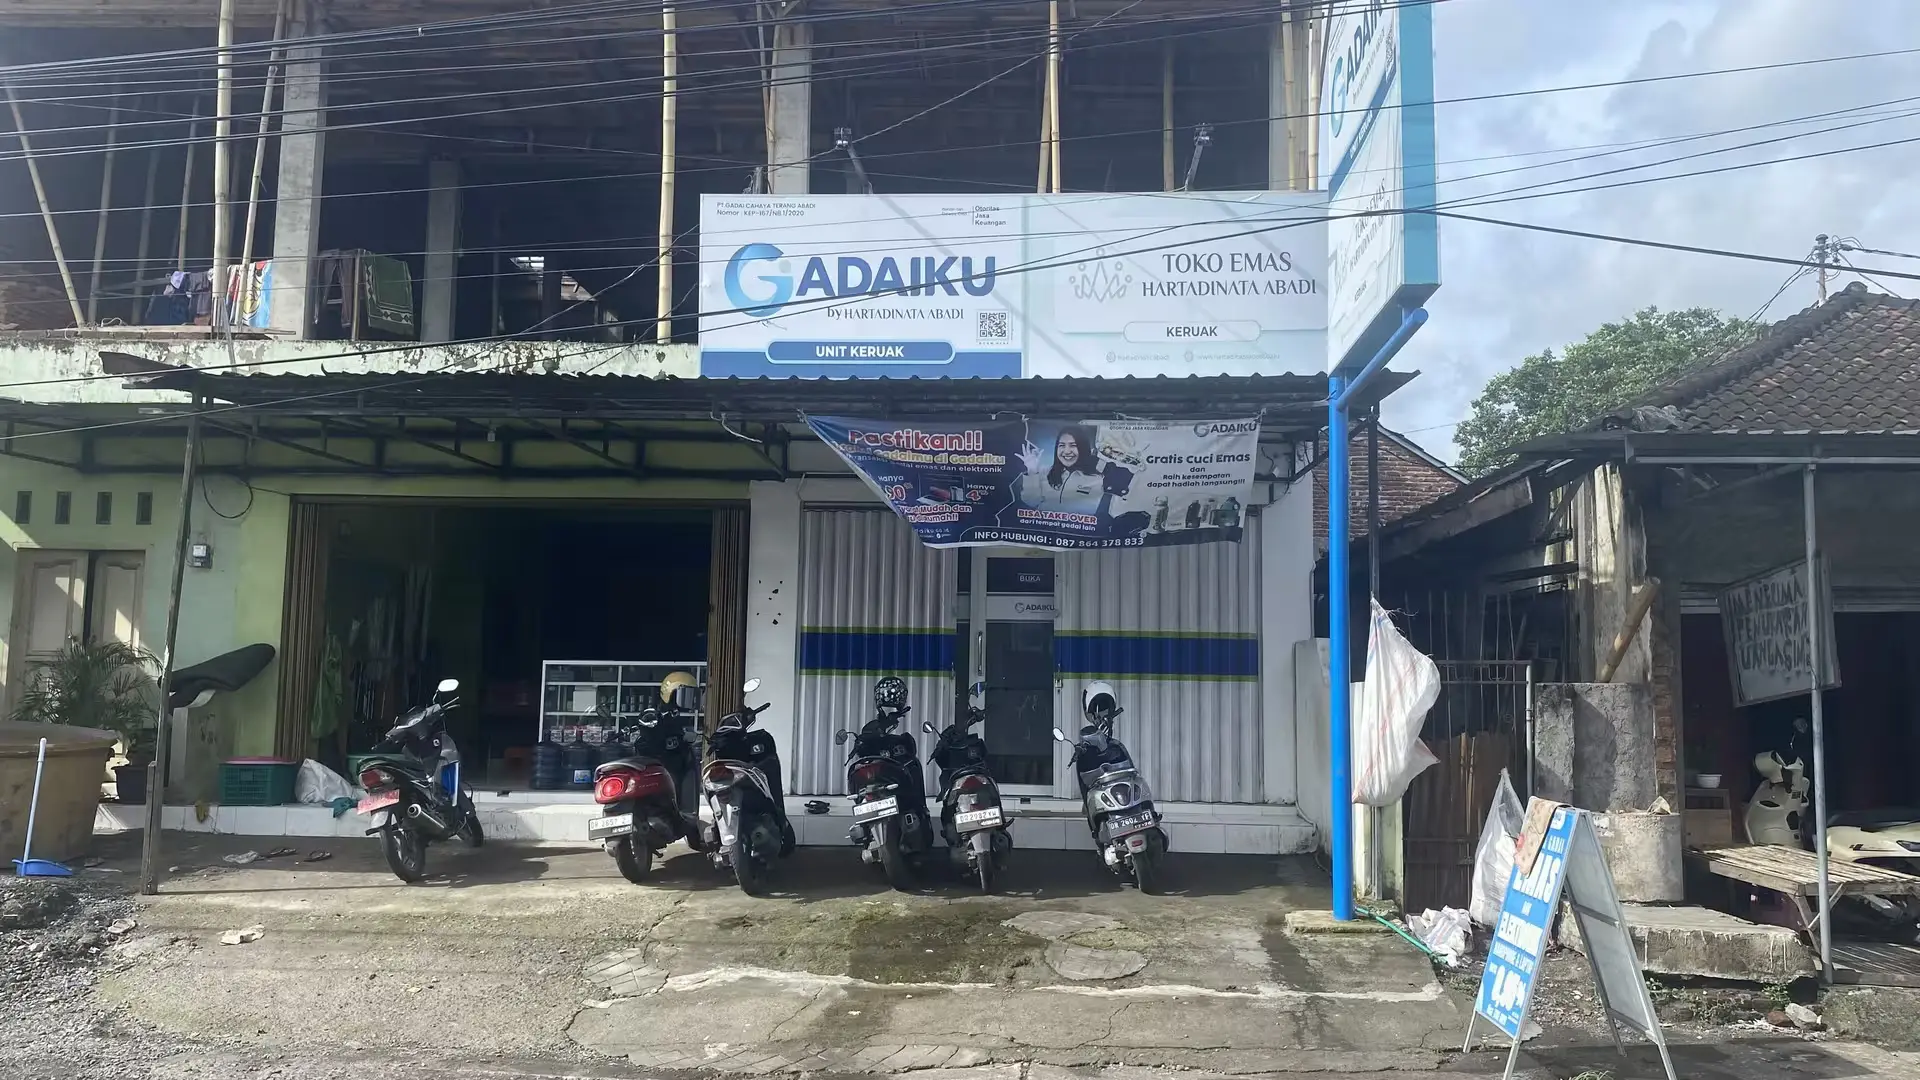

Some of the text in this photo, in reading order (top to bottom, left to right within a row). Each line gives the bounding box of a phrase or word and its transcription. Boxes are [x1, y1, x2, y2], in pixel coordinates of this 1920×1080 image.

[1162, 251, 1292, 273] TOKO EMAS
[724, 242, 996, 318] GADAIKU
[1142, 278, 1316, 297] HARTADINATA ABADI
[827, 307, 964, 320] by HARTADINATA ABADI
[1166, 326, 1218, 337] KERUAK
[816, 345, 904, 357] UNIT KERUAK
[1193, 422, 1257, 438] GADAIKU
[848, 429, 983, 451] Pastikan!!
[934, 453, 949, 464] di
[949, 452, 1006, 465] Gadaiku
[1146, 453, 1250, 464] Gratis Cuci Emas
[1181, 473, 1231, 481] kesempatan
[1201, 479, 1245, 487] langsung!!!
[951, 504, 972, 513] dan
[1017, 509, 1097, 525] BISA TAKE OVER
[1035, 519, 1061, 528] tempat
[1061, 522, 1082, 530] gadai
[974, 531, 999, 540] INFO
[1000, 532, 1047, 543] HUBUNGI
[1056, 538, 1075, 547] 087
[1101, 538, 1121, 546] 378
[1124, 537, 1145, 546] 833
[1015, 602, 1055, 613] GADAIKU
